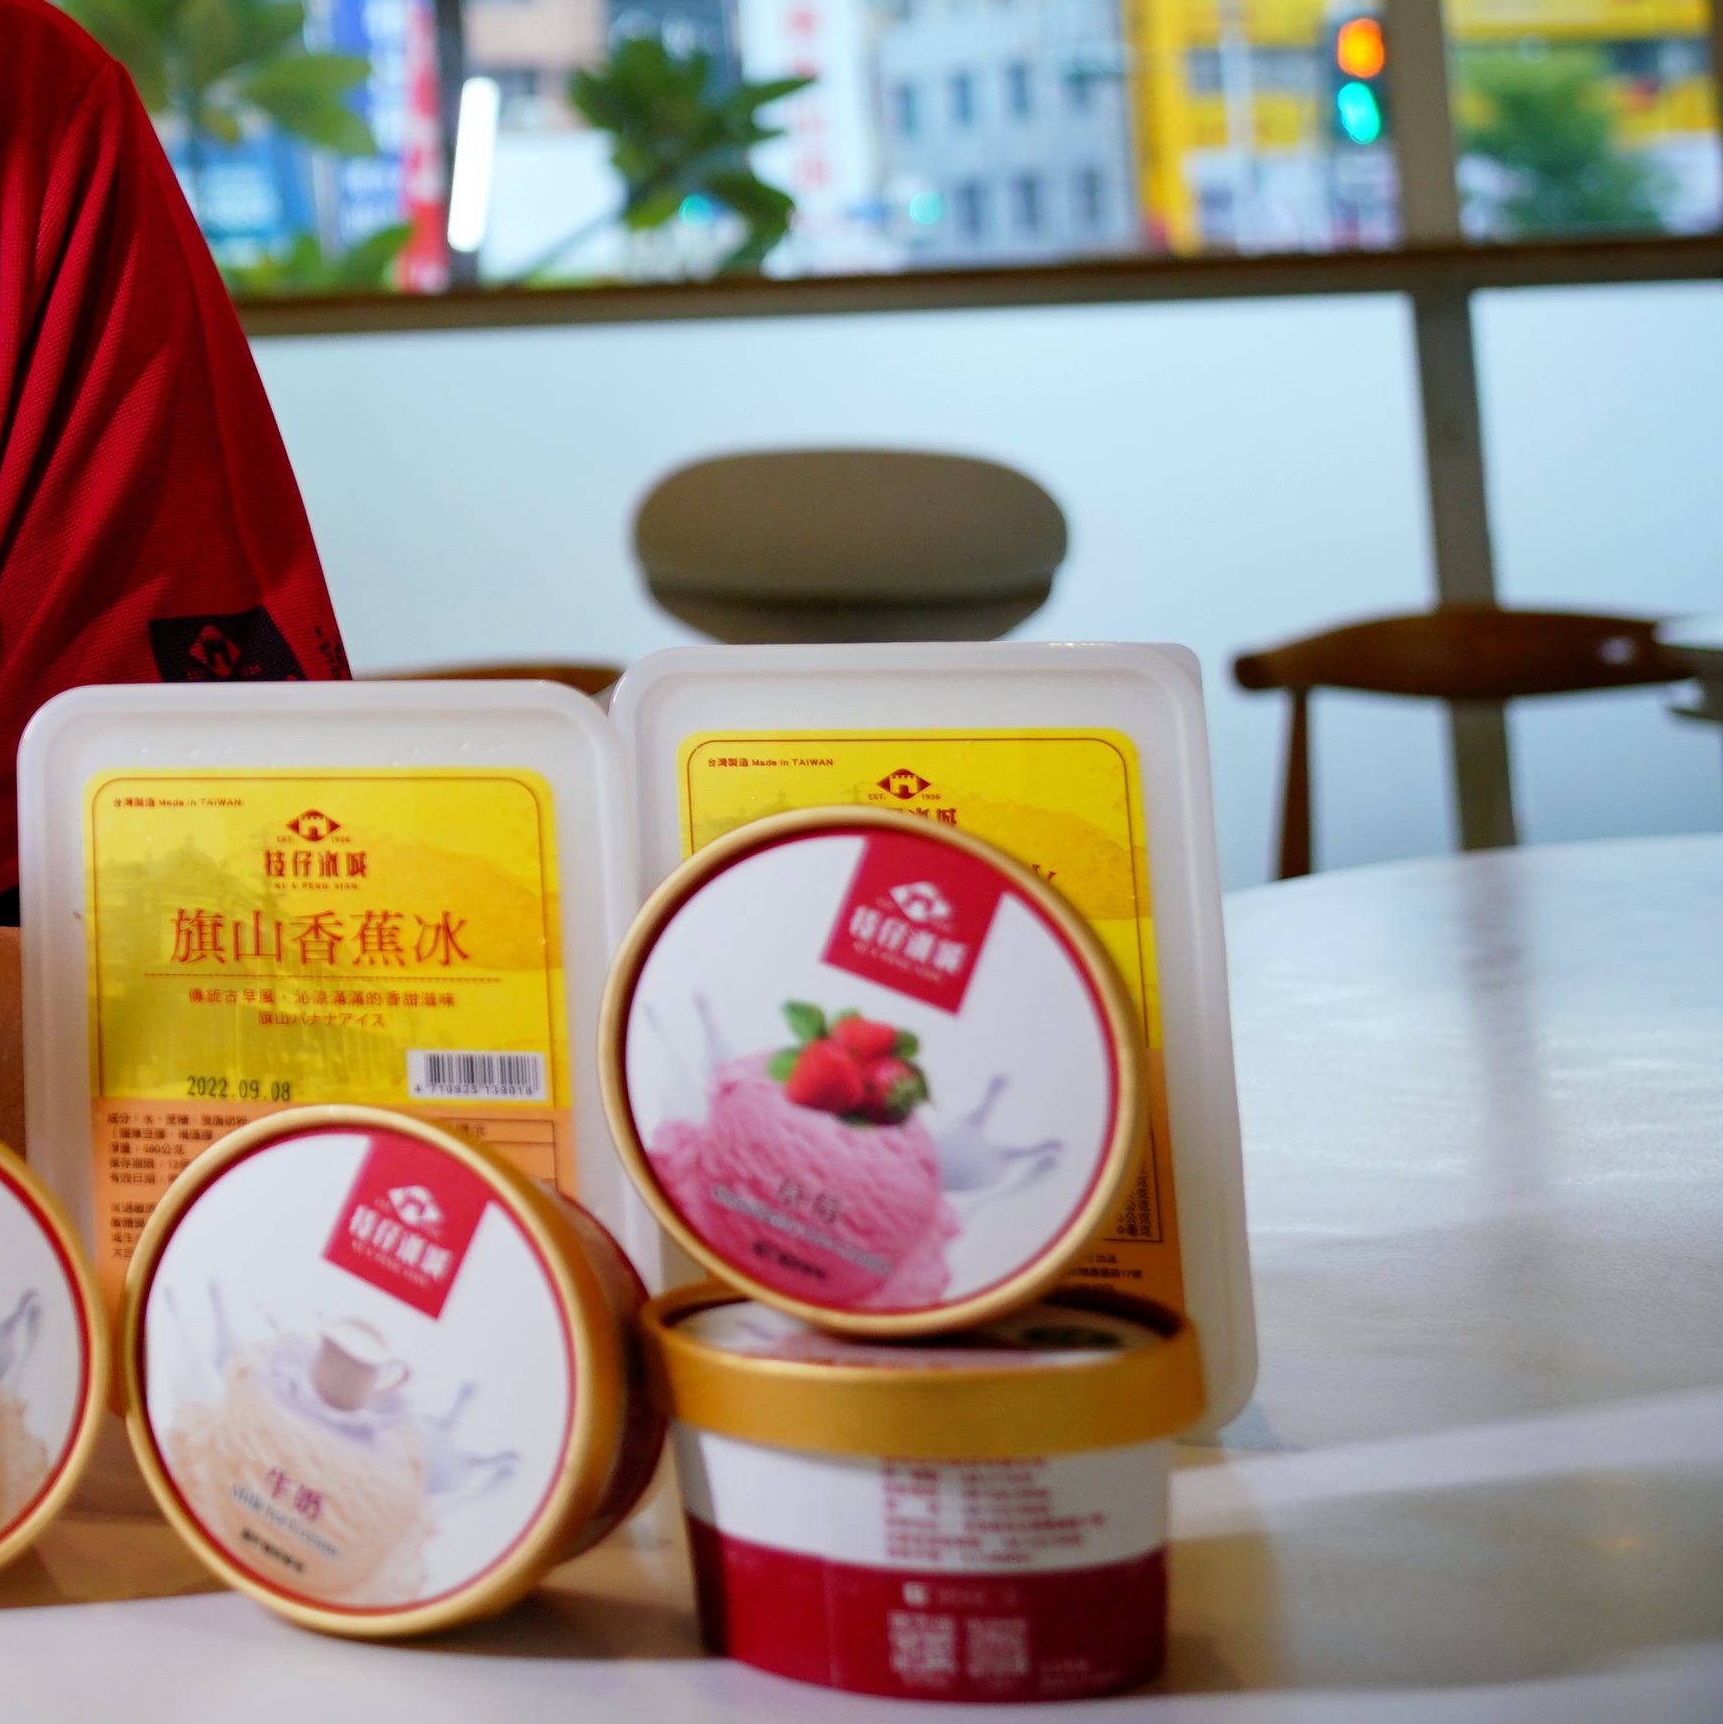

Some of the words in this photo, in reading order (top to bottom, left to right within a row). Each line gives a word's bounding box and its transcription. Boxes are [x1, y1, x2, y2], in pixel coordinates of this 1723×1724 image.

[707, 757, 749, 768] 台灣製造
[751, 758, 777, 767] Made
[780, 758, 789, 767] in
[791, 758, 834, 767] TAIWAN
[158, 798, 185, 807] Made
[187, 798, 197, 807] in
[200, 797, 243, 807] TAIWAN
[264, 849, 367, 878] 枝仔冰城
[170, 908, 470, 966] 旗山香蕉冰
[187, 1076, 292, 1102] 2022.09.08
[267, 1468, 324, 1521] 牛奶
